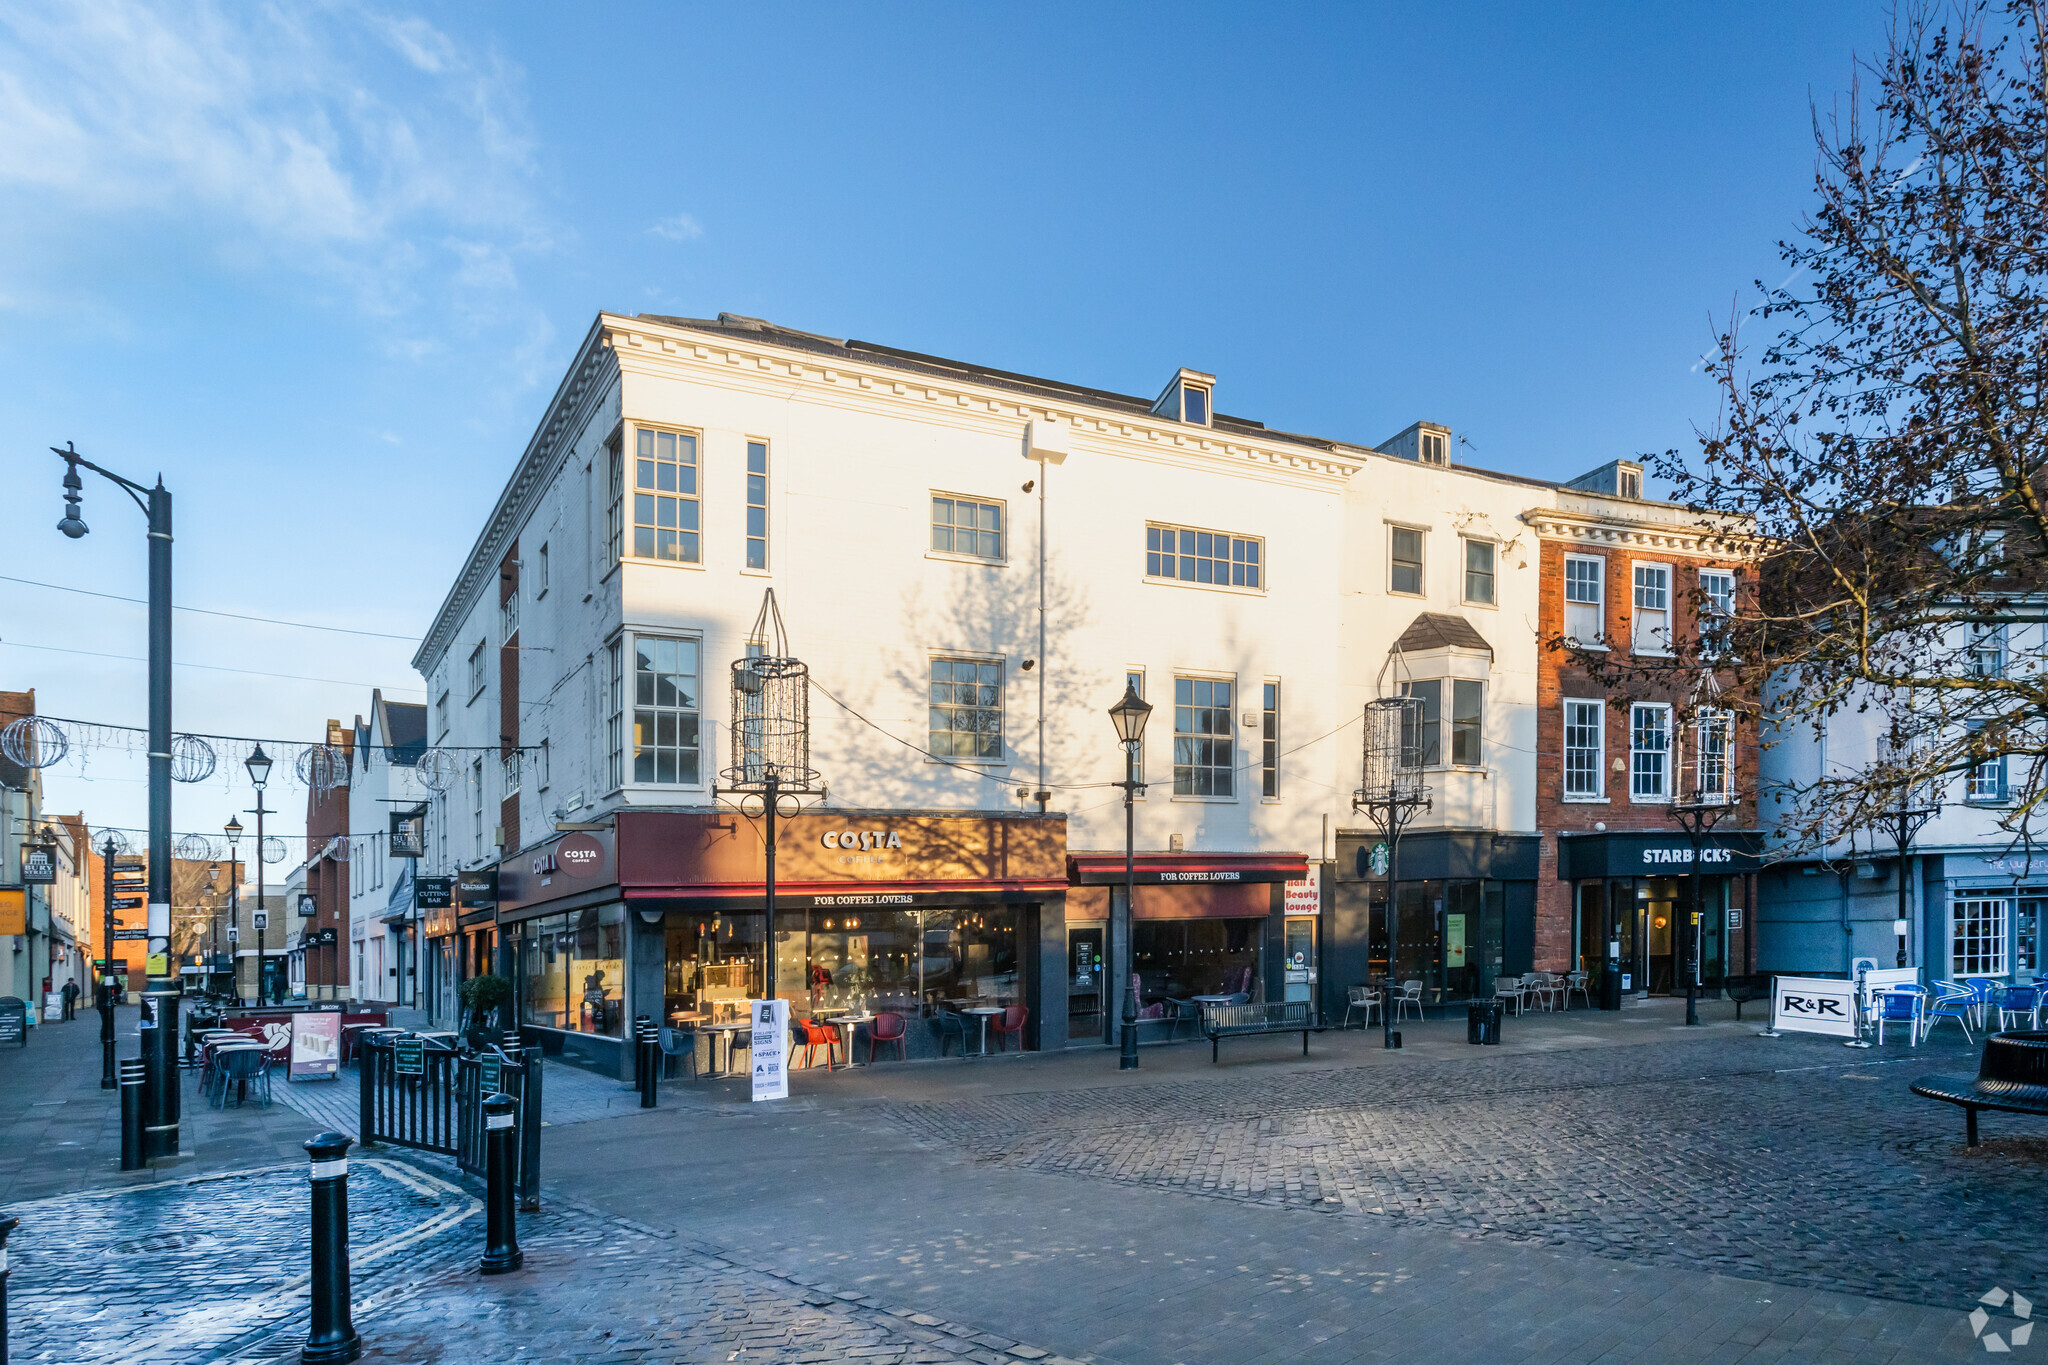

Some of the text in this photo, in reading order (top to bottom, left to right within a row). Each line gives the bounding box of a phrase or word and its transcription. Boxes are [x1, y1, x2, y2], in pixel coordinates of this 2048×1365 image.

[821, 831, 902, 851] COSTA
[564, 850, 597, 859] COSTA
[839, 855, 884, 864] COFFEE
[1161, 872, 1240, 881] FOR COFFEE LOVERS
[1309, 878, 1316, 887] &
[814, 895, 913, 905] FOR COFFEE LOVERS
[1286, 890, 1318, 901] Beauty
[1286, 903, 1318, 913] Lounge
[1784, 996, 1846, 1016] R&R
